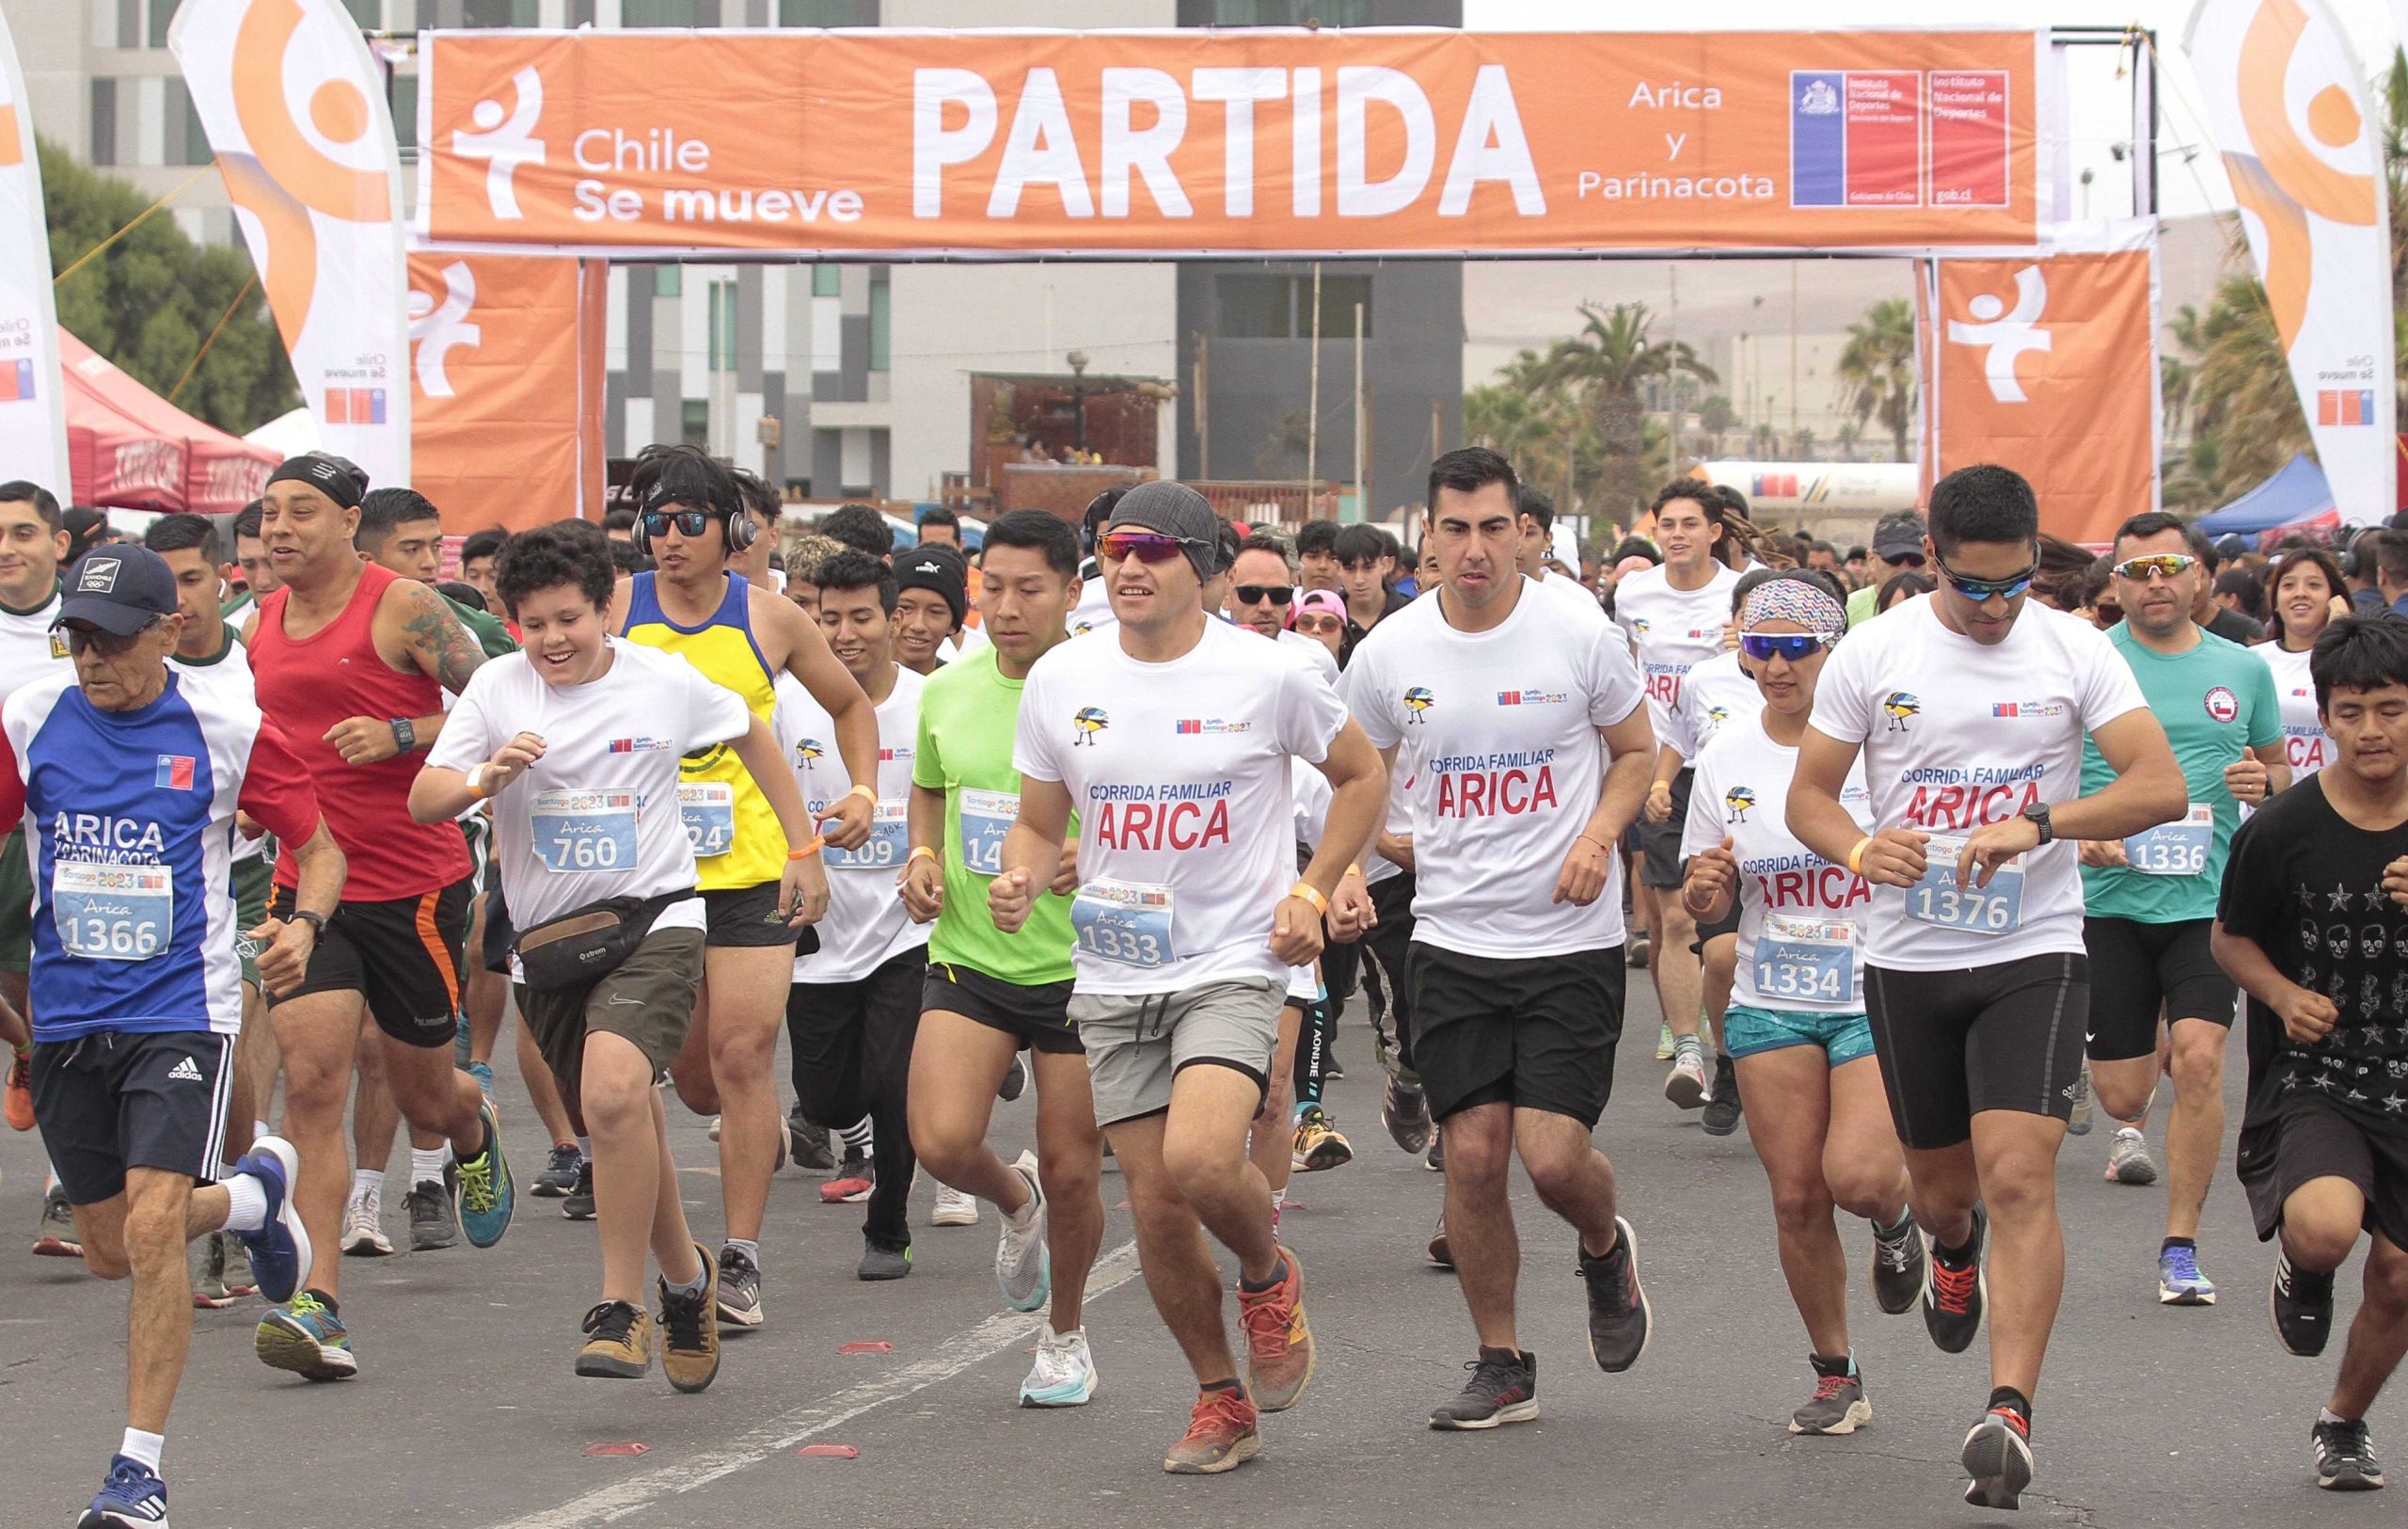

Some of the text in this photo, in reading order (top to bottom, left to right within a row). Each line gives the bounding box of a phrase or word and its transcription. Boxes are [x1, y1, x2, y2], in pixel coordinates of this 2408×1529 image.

[1933, 75, 1986, 88] Instituto
[1628, 81, 1723, 109] Arica
[1933, 90, 2003, 103] Nacional de
[1933, 107, 1987, 119] Deportes
[573, 127, 710, 172] Chile
[913, 64, 1546, 218] PARTIDA
[1665, 133, 1687, 162] y
[1578, 170, 1775, 199] Parinacota
[573, 179, 864, 223] Se mueve
[1936, 189, 1972, 203] gob.cl
[1645, 674, 1681, 702] ARI
[1228, 722, 1251, 732] 2023
[1430, 748, 1555, 773] CORRIDA FAMILIAR
[1901, 768, 1968, 784] CORRIDA
[1090, 781, 1231, 800] CORRIDA FAMILIAR
[1438, 765, 1558, 819] ARICA
[537, 794, 604, 810] Santiago 2023
[997, 799, 1020, 815] 202
[1903, 782, 2039, 829] ARICA
[55, 811, 165, 852] ARICA
[561, 820, 605, 834] Arica
[984, 822, 1008, 836] Ari
[1098, 799, 1229, 851] ARICA
[2150, 829, 2189, 841] Arica
[688, 825, 723, 851] 24
[1925, 843, 1953, 854] ntiago
[553, 836, 617, 867] 760
[969, 837, 1002, 869] 14
[2135, 844, 2205, 869] 1336
[1743, 855, 1800, 874] CORRIDA
[63, 869, 135, 888] Santiago 2023
[1757, 867, 1871, 909] ARICA
[1110, 887, 1137, 903] 2023
[84, 899, 133, 915] Arica
[1917, 887, 2008, 929] 1376
[1096, 910, 1136, 929] Arica
[67, 917, 158, 954] 1366
[1789, 924, 1821, 938] 2023
[585, 946, 607, 958] xtrem
[1084, 926, 1161, 964] 1333
[1776, 947, 1820, 962] Arica
[1759, 962, 1841, 997] 1334
[1308, 1028, 1323, 1077] AONIJIE
[167, 1070, 203, 1081] adidas
